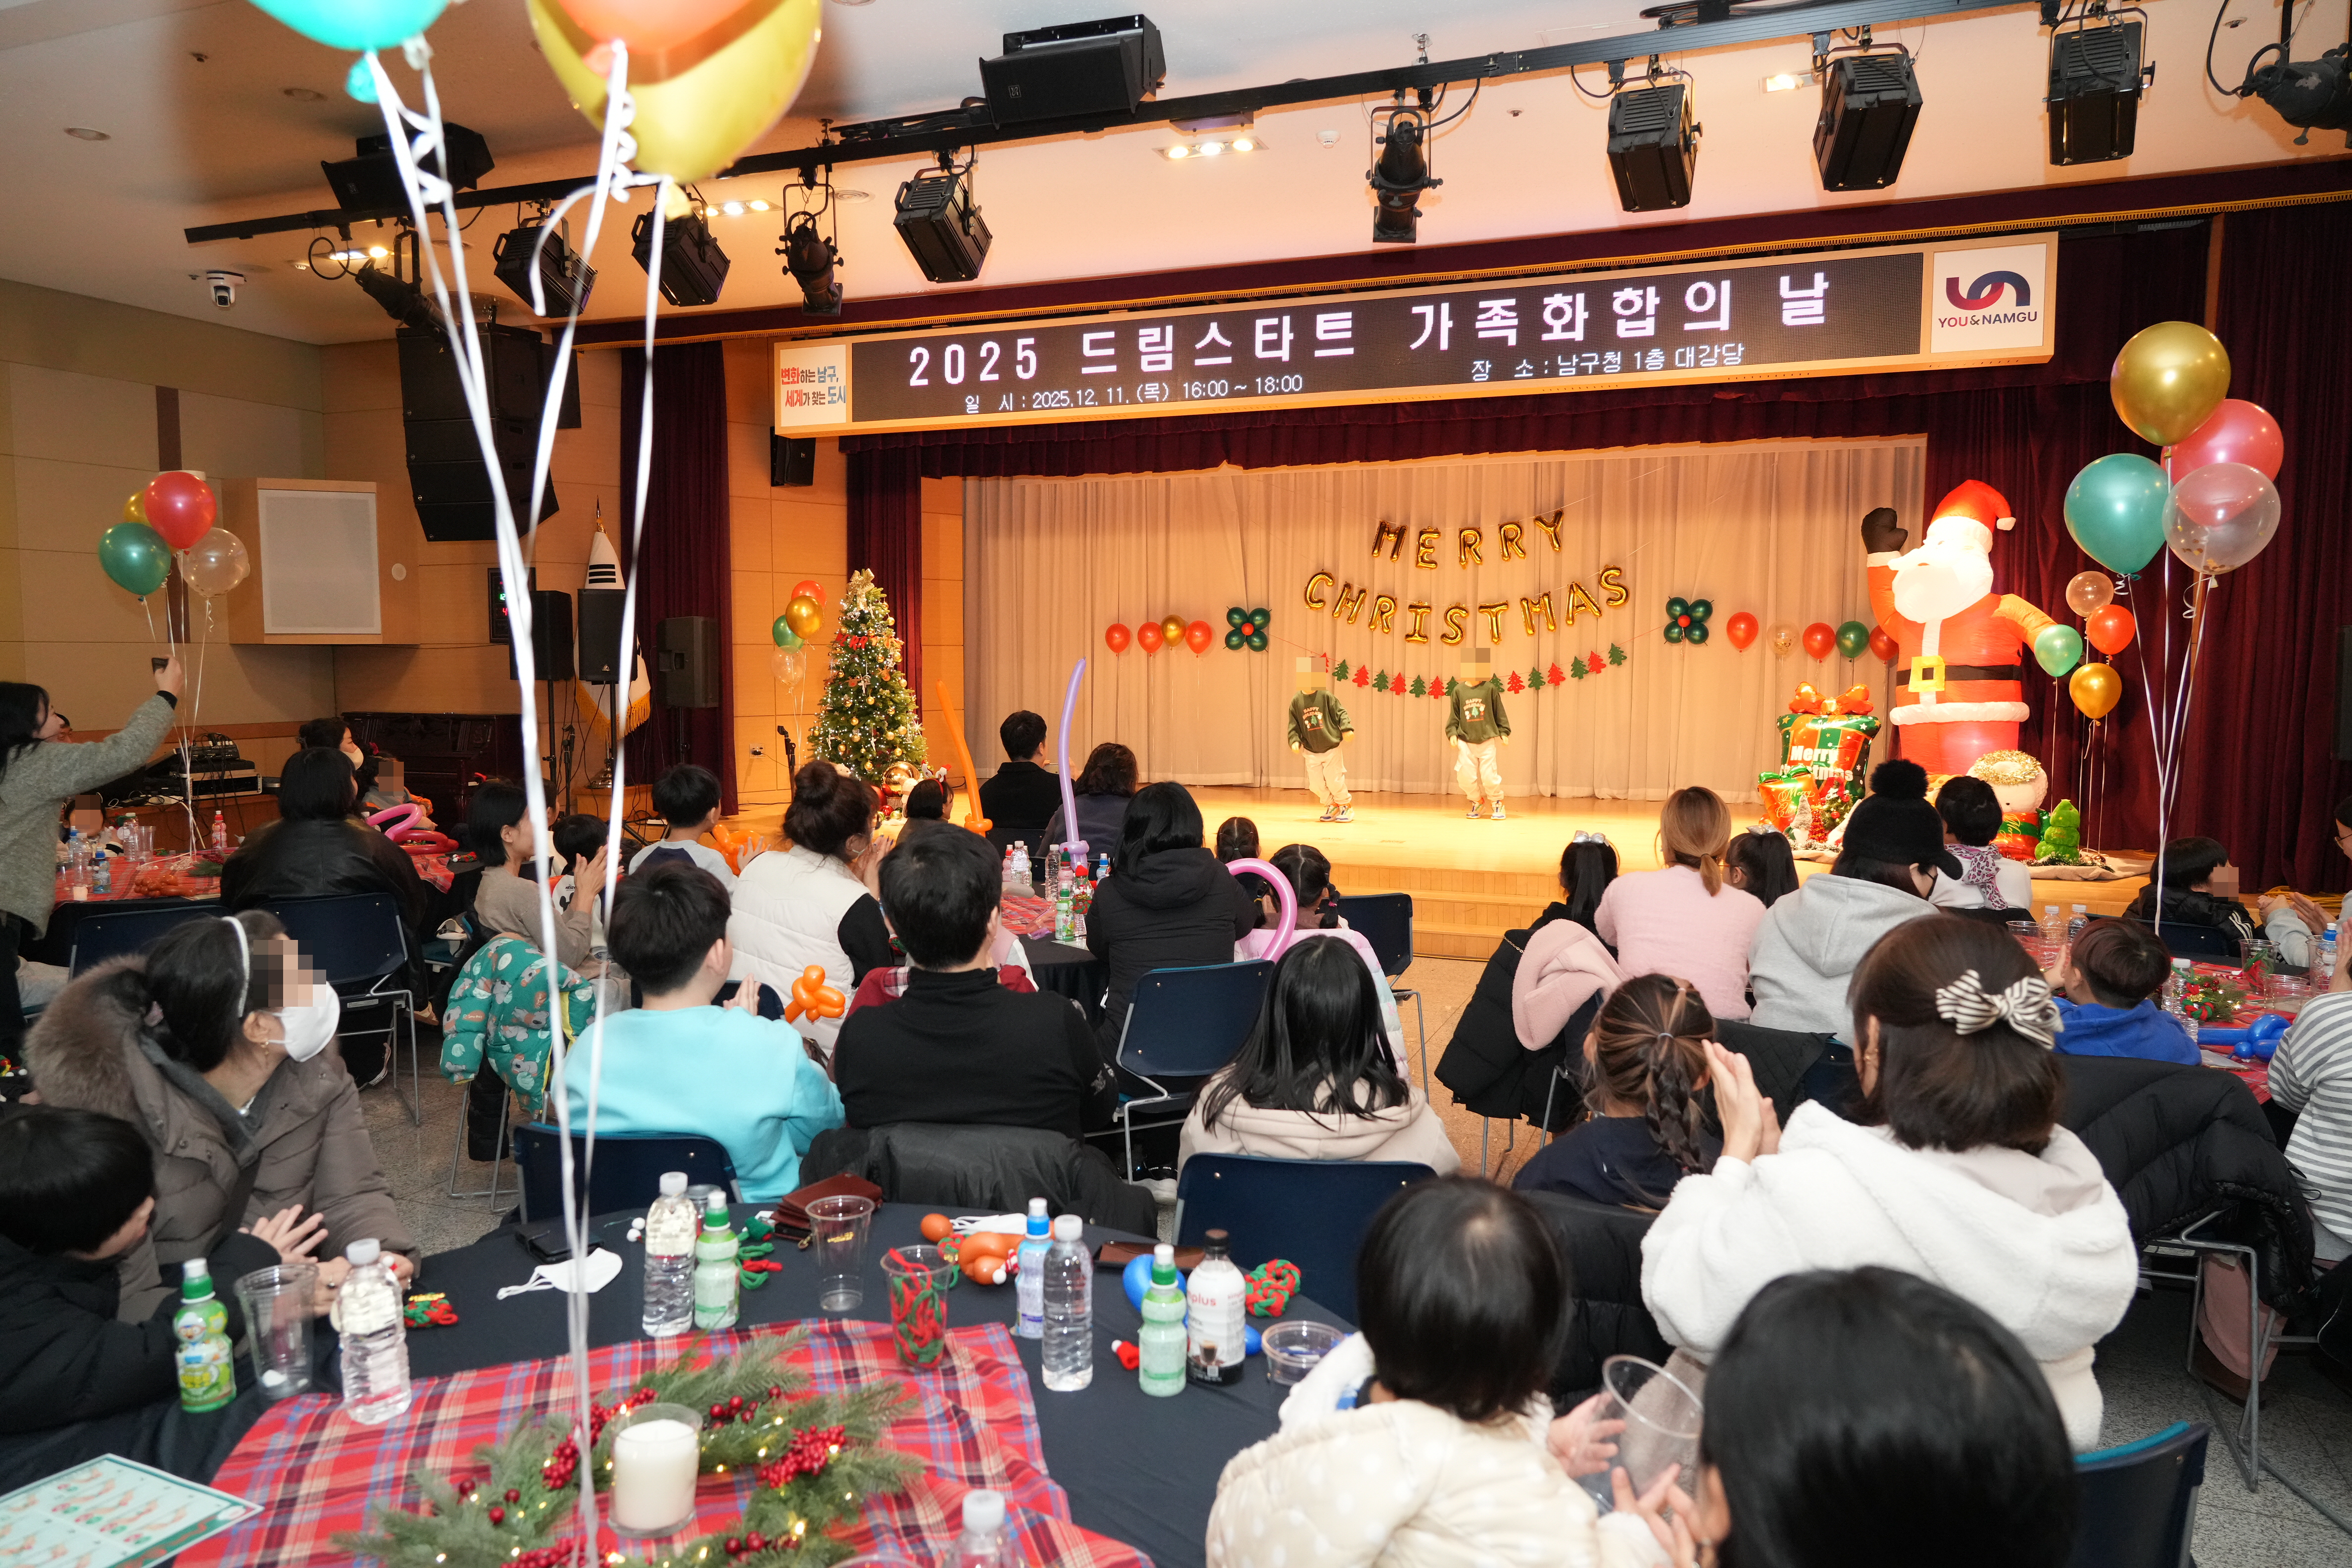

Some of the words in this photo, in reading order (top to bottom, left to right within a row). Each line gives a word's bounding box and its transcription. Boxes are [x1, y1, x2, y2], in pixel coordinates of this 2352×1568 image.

[910, 338, 1038, 387] 2025
[1081, 311, 1354, 374] 드림스타트
[1779, 272, 1829, 326] 날
[1938, 311, 2038, 328] YOU&NAMGU
[781, 367, 816, 385] 변화하는
[817, 366, 839, 383] 남구,
[1558, 351, 1622, 376] 남구청
[1634, 348, 1666, 371] 1층
[1675, 343, 1746, 368] 대강당
[785, 389, 810, 407] 세계가
[812, 391, 826, 406] 찾는
[828, 385, 846, 404] 도시
[966, 395, 980, 414] 일
[999, 393, 1013, 411] 시
[1137, 383, 1169, 403] (목)
[1183, 380, 1228, 399] 16:00
[1256, 375, 1303, 394] 18:00
[1371, 509, 1565, 570] MERRY
[1303, 564, 1630, 646] CHRISTMAS
[1790, 745, 1839, 764] Merry
[1778, 787, 1815, 802] Merry
[2000, 813, 2021, 846] Merry
